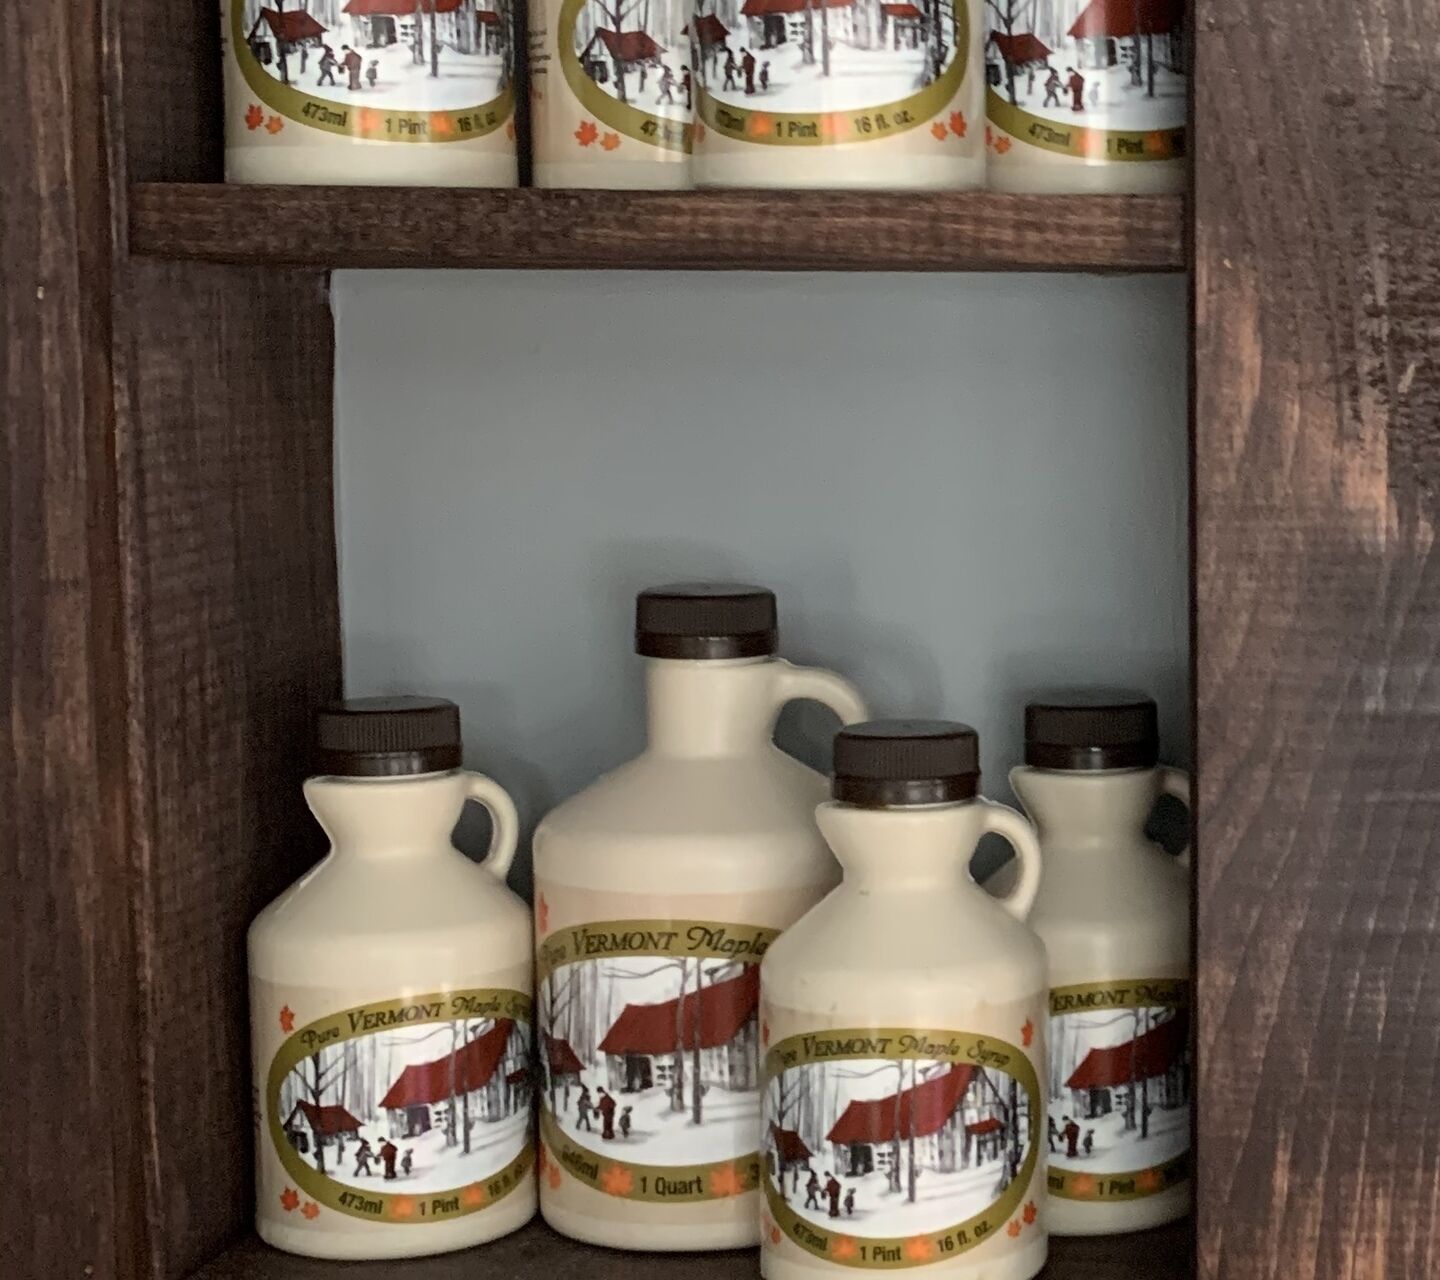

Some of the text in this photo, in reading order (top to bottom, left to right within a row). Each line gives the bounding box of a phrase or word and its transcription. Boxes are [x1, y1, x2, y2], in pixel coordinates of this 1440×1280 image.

[302, 101, 347, 128] 473ml
[385, 118, 392, 134] 1
[399, 119, 428, 136] Pint
[775, 122, 782, 139] 1
[788, 120, 818, 140] Pint
[855, 116, 871, 134] 16
[572, 928, 678, 955] VERMONT
[1052, 990, 1130, 1012] ERMONT
[301, 1026, 340, 1049] Pure
[347, 1003, 446, 1033] VERMONT
[802, 1036, 894, 1058] VERMONT
[641, 1177, 648, 1194] 1
[655, 1176, 704, 1197] Quart
[339, 1191, 383, 1215] 473ml
[419, 1203, 426, 1217] 1
[432, 1198, 460, 1216] Pint
[860, 1245, 867, 1261] 1
[872, 1245, 902, 1263] Pint
[937, 1235, 955, 1253] 16
